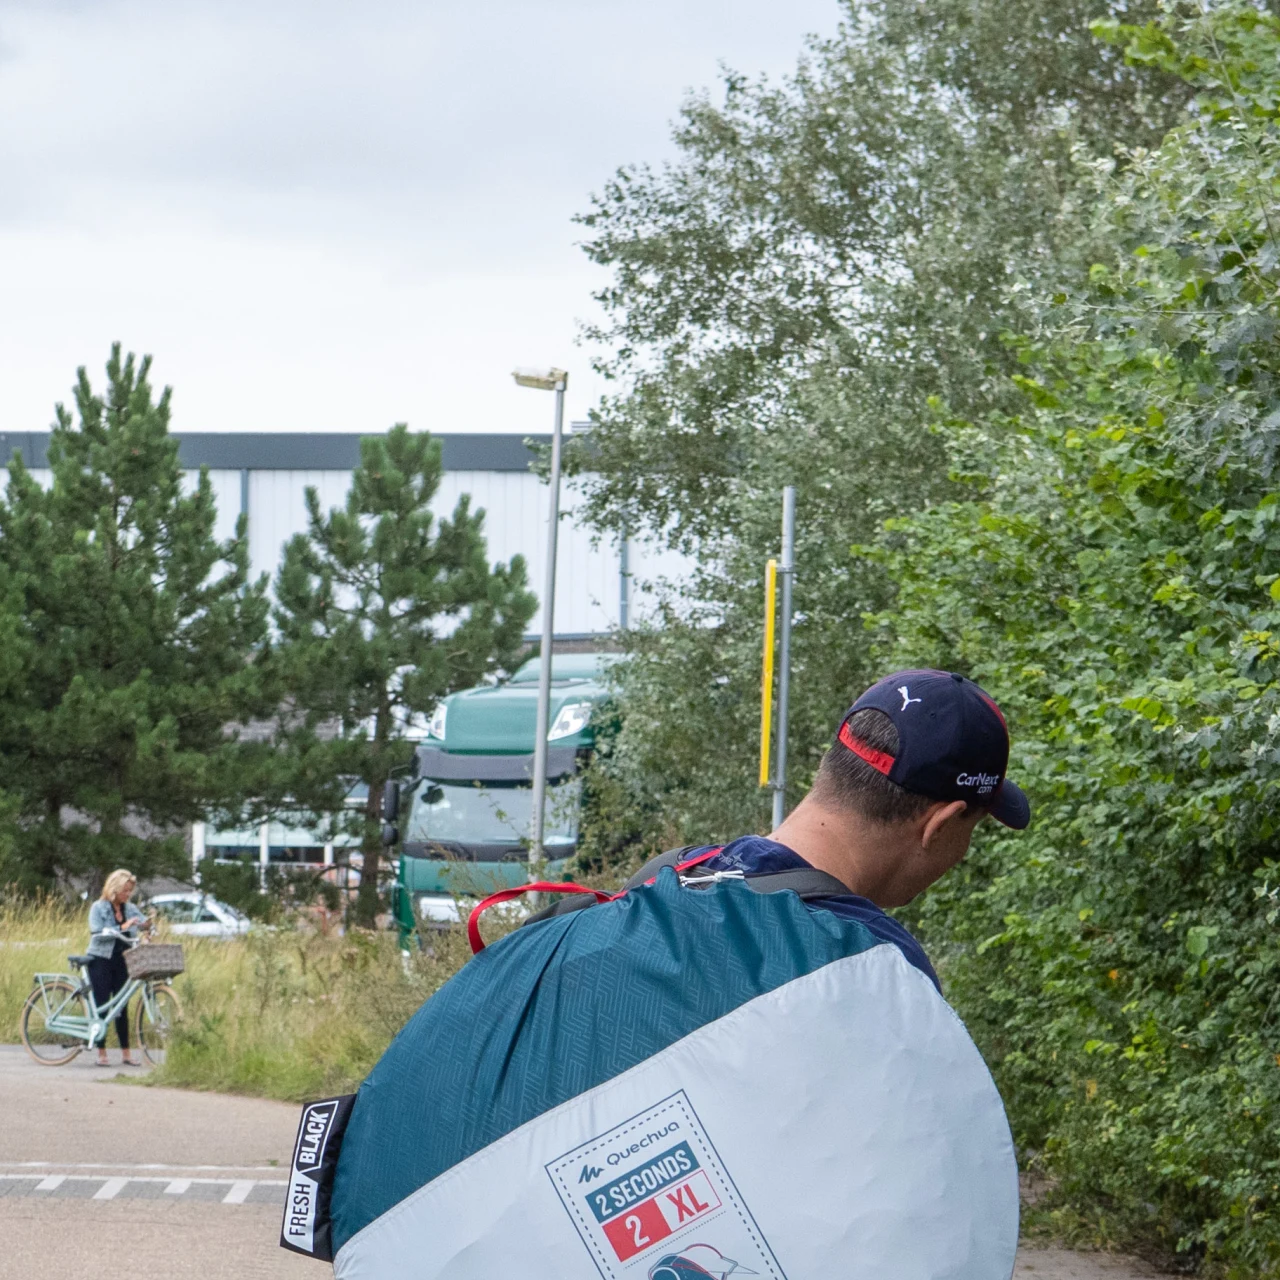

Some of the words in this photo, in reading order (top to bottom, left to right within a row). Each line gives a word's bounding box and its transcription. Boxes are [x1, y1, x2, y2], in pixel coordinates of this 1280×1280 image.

[956, 772, 999, 786] CarNext
[977, 786, 992, 794] .com
[299, 1110, 329, 1164] BLACK
[606, 1121, 680, 1166] Quechua
[289, 1183, 311, 1236] FRESH
[595, 1194, 613, 1217] 2
[609, 1149, 692, 1208] SECONDS
[625, 1215, 651, 1248] 2
[665, 1183, 710, 1223] XL
